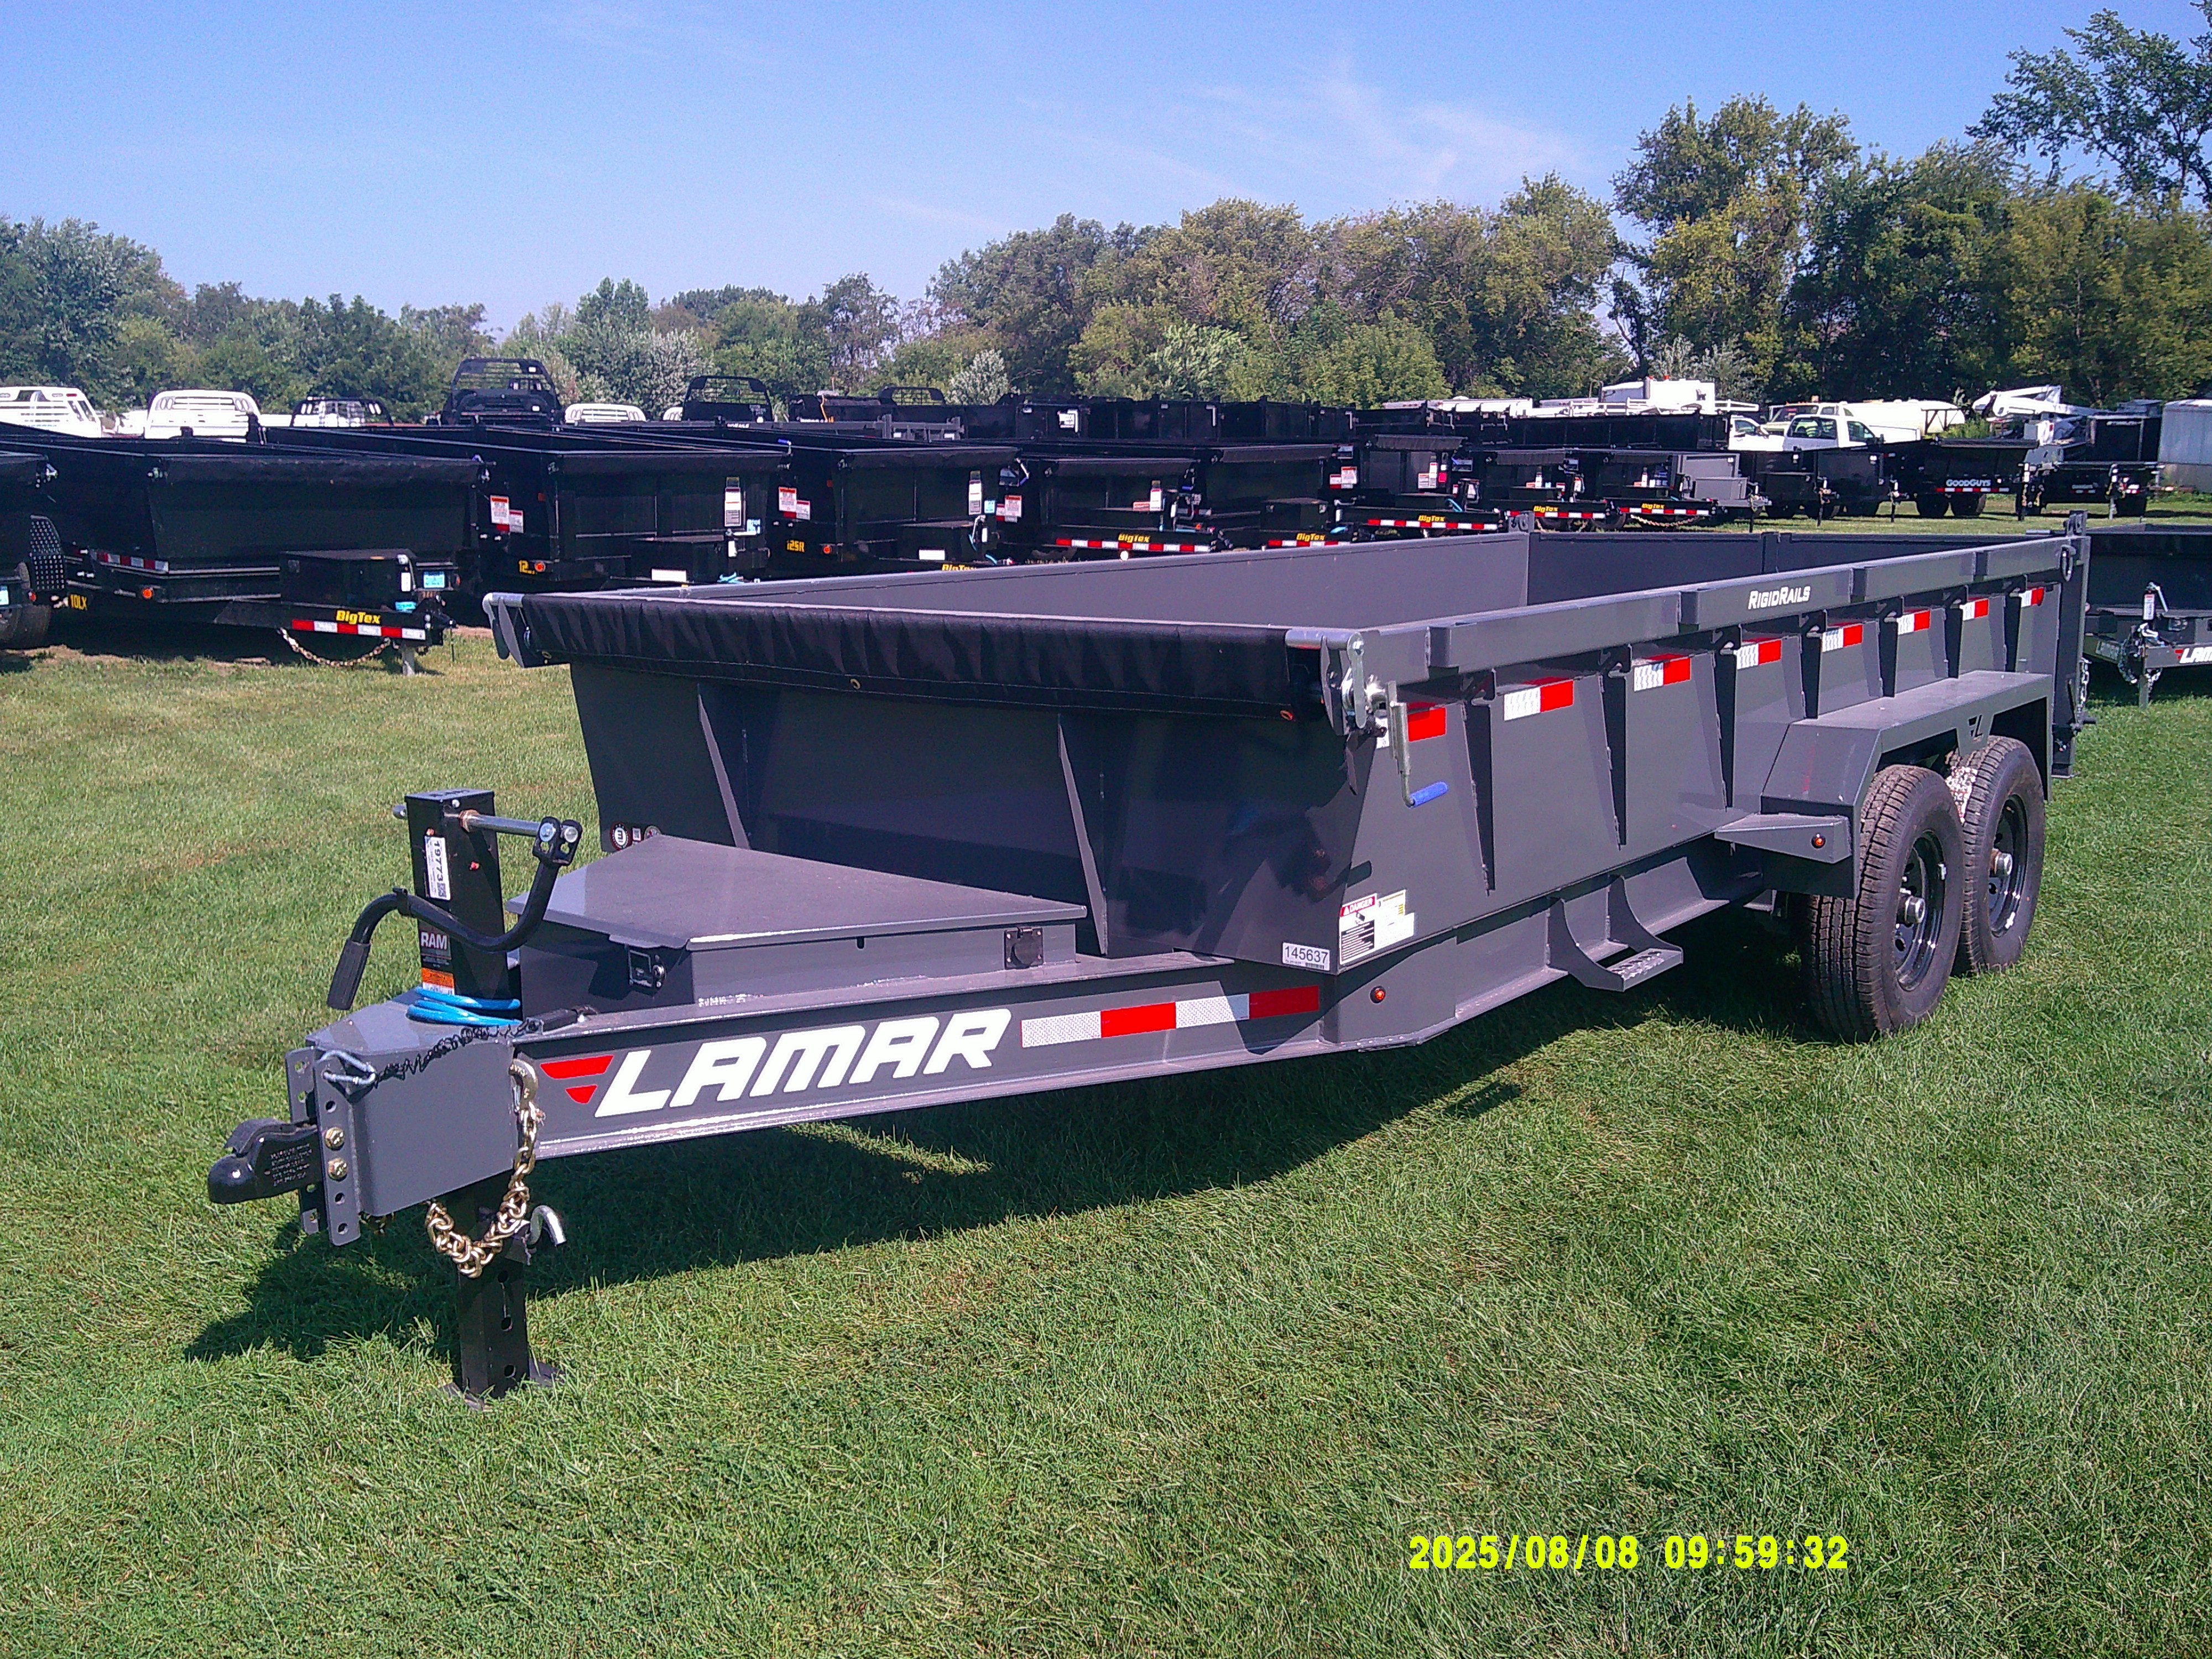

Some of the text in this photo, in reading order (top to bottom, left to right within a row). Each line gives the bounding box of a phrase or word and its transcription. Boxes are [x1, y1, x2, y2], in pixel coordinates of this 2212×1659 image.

[336, 610, 381, 624] BigTex
[434, 841, 444, 882] 19773
[1349, 897, 1374, 912] DANGER
[421, 931, 447, 950] RAM
[1285, 946, 1328, 964] 145637
[595, 1008, 1013, 1118] LAMAR
